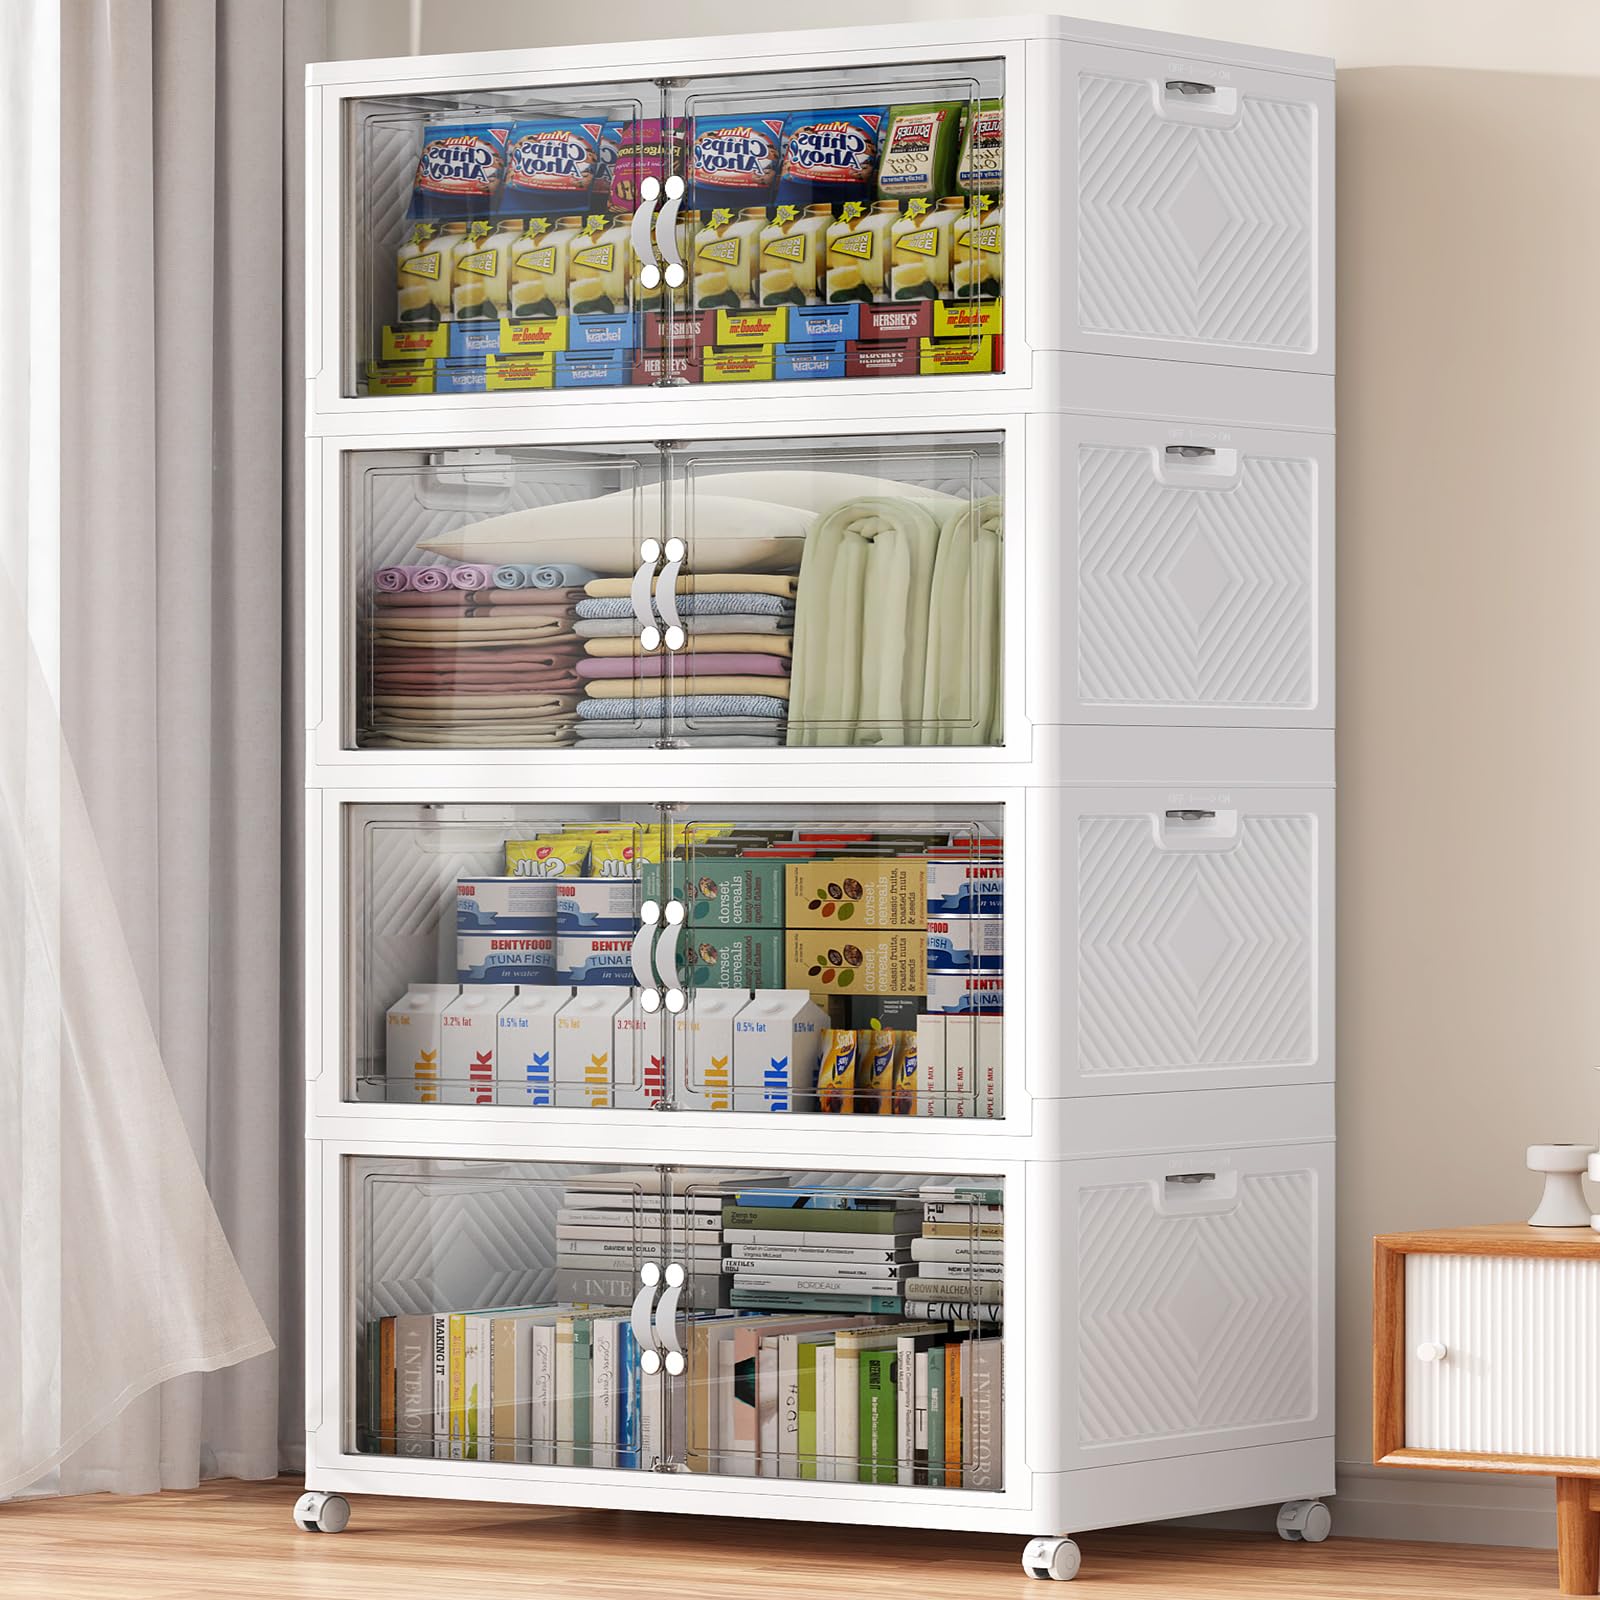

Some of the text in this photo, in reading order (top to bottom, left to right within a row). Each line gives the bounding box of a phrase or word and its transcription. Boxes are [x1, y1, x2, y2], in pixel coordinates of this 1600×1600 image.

[805, 319, 843, 334] krackel
[873, 313, 917, 327] HERSHEY'S
[658, 322, 701, 335] HSHY'S
[644, 359, 687, 372] HEREY'S
[718, 880, 730, 924] dorset
[731, 876, 743, 924] cereals
[864, 882, 875, 925] dorset
[879, 876, 888, 925] cereals
[889, 895, 897, 925] classic
[491, 939, 552, 951] BENTYFOOD
[930, 939, 947, 949] FISH
[489, 954, 552, 966] TUNA FISH
[590, 955, 623, 966] TUNA
[731, 941, 743, 989] cereals
[718, 946, 730, 989] dorset
[864, 947, 875, 992] dorset
[879, 943, 889, 992] cereals
[444, 1017, 472, 1027] 3.2% fat
[500, 1018, 528, 1028] 0.5% fat
[736, 1022, 766, 1032] 0.5% fat
[797, 1281, 841, 1290] BORDEAUX
[909, 1284, 984, 1296] GROWN ALCHEMST
[436, 1318, 445, 1362] MAKING
[436, 1364, 445, 1376] IT
[972, 1372, 992, 1487] INTERIORS
